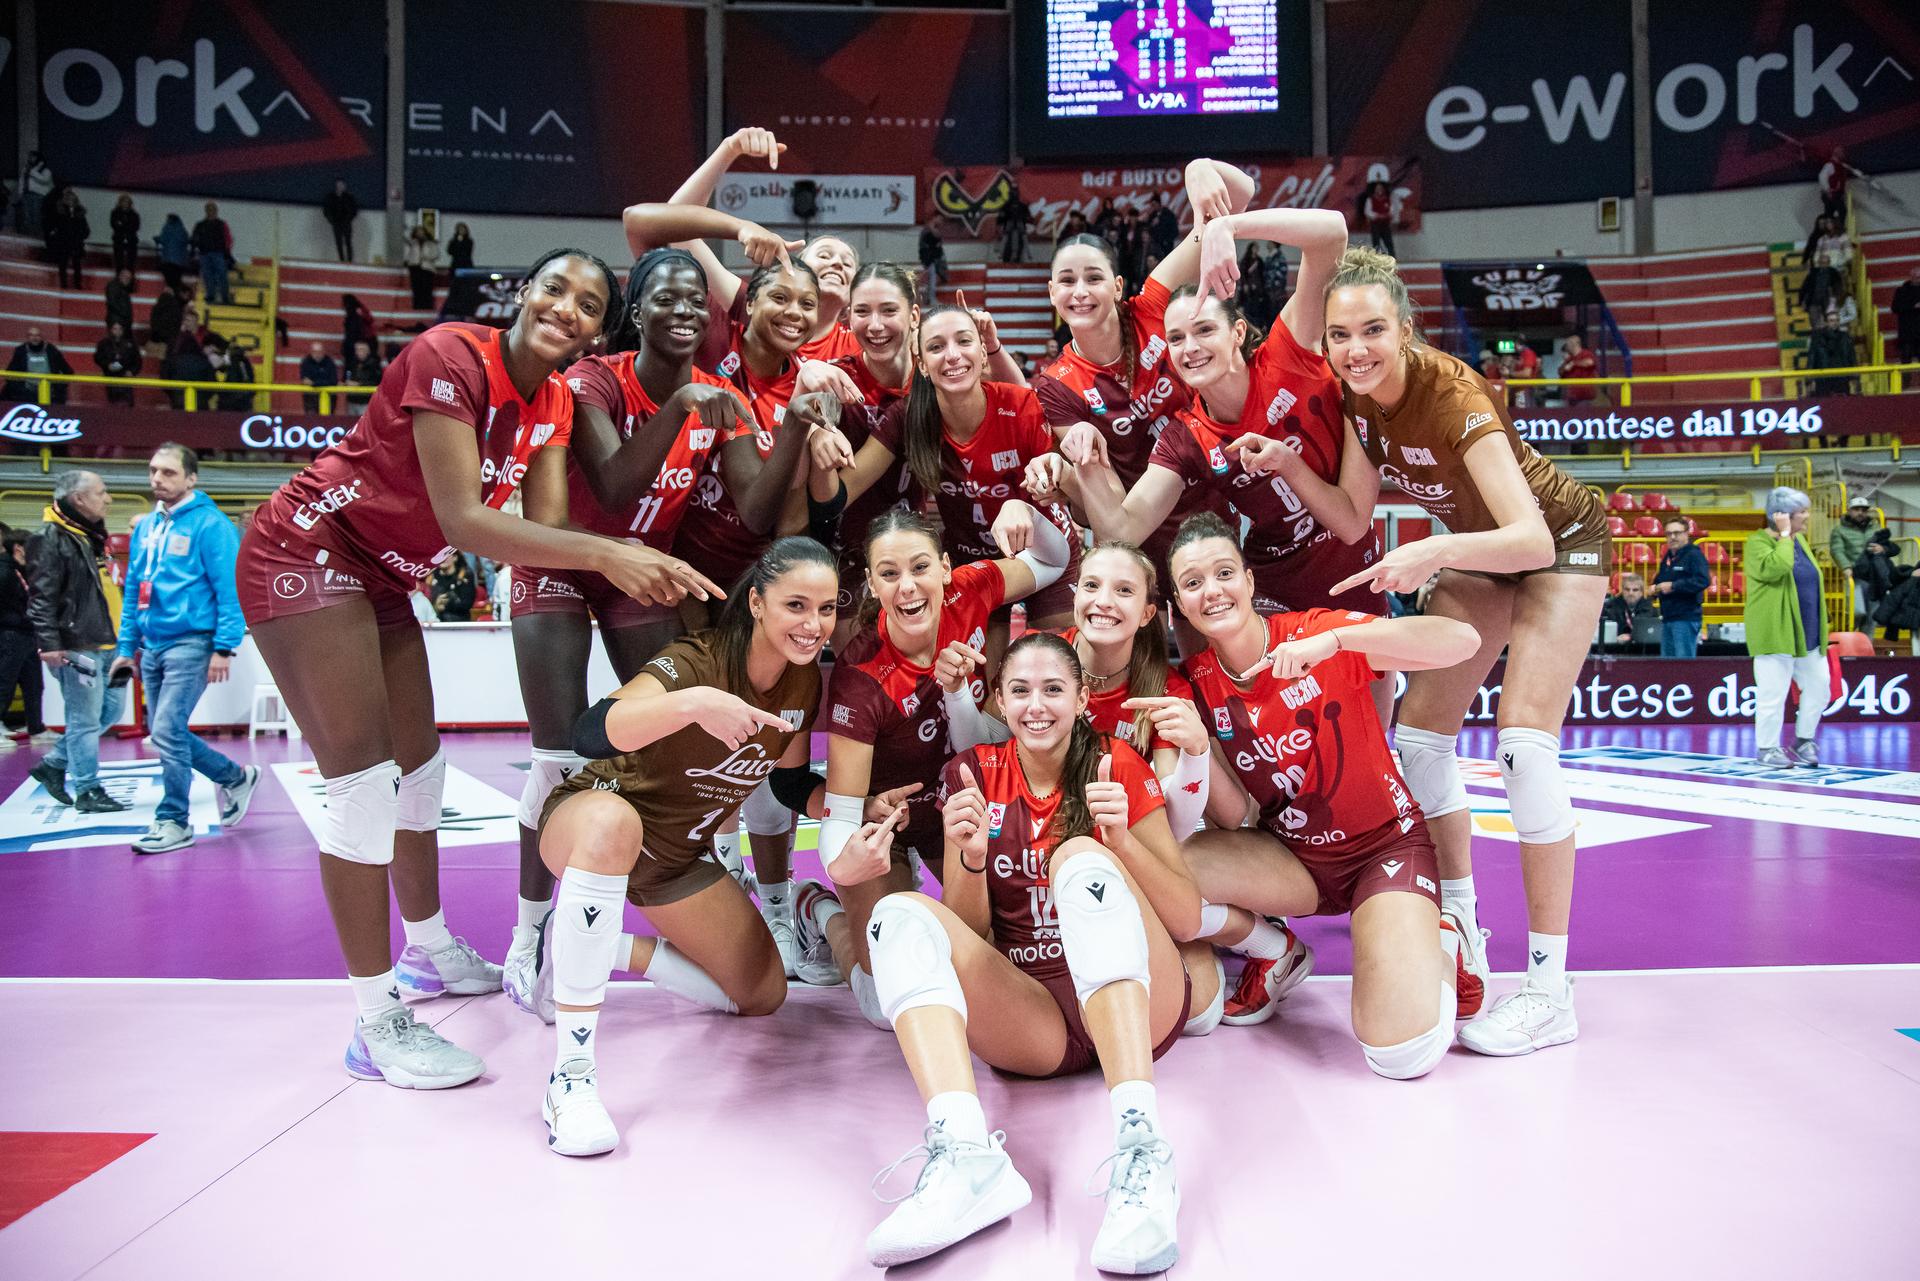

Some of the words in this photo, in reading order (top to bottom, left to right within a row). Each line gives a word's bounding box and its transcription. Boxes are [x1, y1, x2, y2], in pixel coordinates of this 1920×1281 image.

[0, 36, 260, 137] ork
[1426, 23, 1860, 152] e-work
[1121, 168, 1182, 187] BUSTO
[0, 403, 83, 442] Laica
[240, 414, 356, 449] Ciocc
[1461, 411, 1495, 439] Laica
[1682, 408, 1735, 438] dal
[1740, 404, 1823, 434] 1946
[1379, 464, 1453, 501] Laica
[629, 495, 663, 533] 11
[1708, 673, 1757, 717] da
